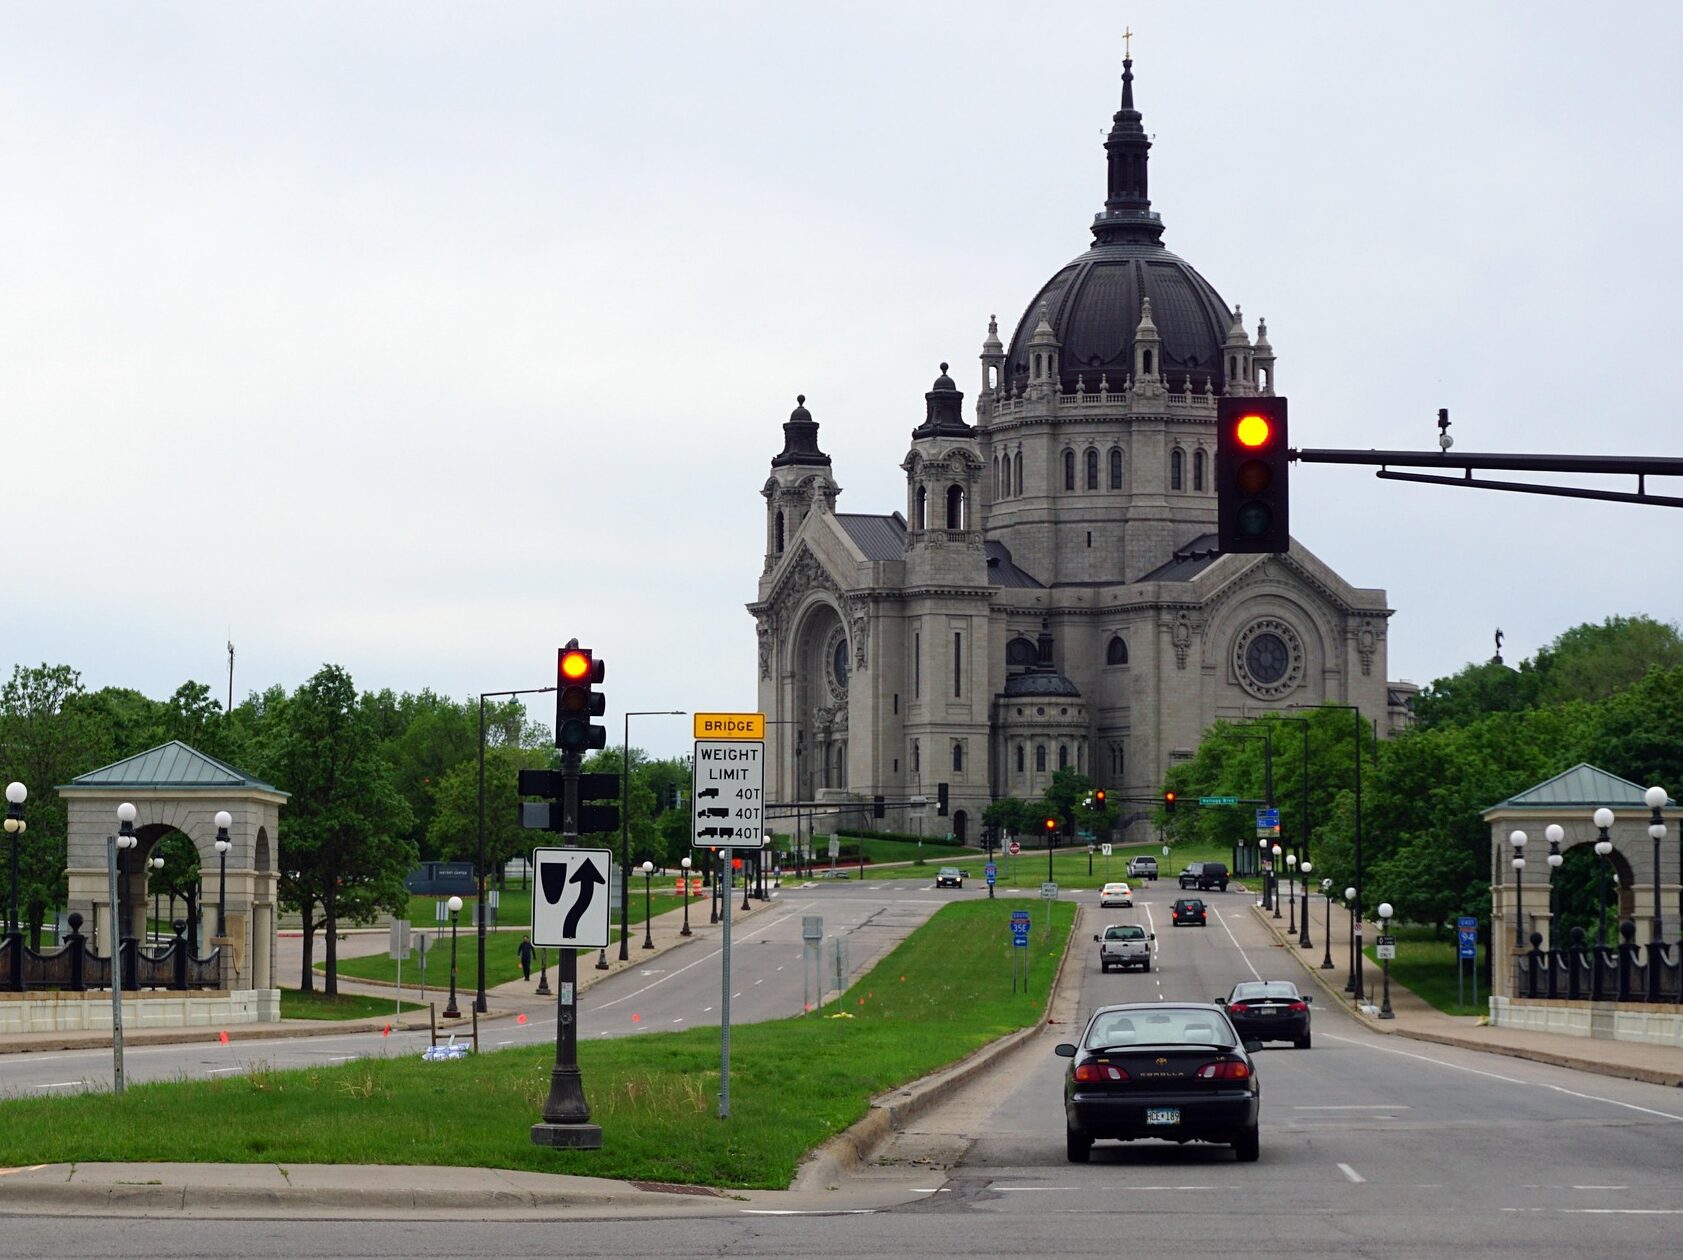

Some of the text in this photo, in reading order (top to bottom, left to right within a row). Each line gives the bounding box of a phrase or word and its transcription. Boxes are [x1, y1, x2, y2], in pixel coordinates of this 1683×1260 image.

[704, 720, 754, 731] BRIDGE
[701, 749, 758, 761] WEIGHT
[709, 768, 749, 780] LIMIT
[736, 788, 760, 800] 40T
[735, 808, 760, 819] 40T
[735, 828, 760, 839] 40T
[1012, 923, 1027, 933] 35E
[1461, 932, 1475, 942] 94
